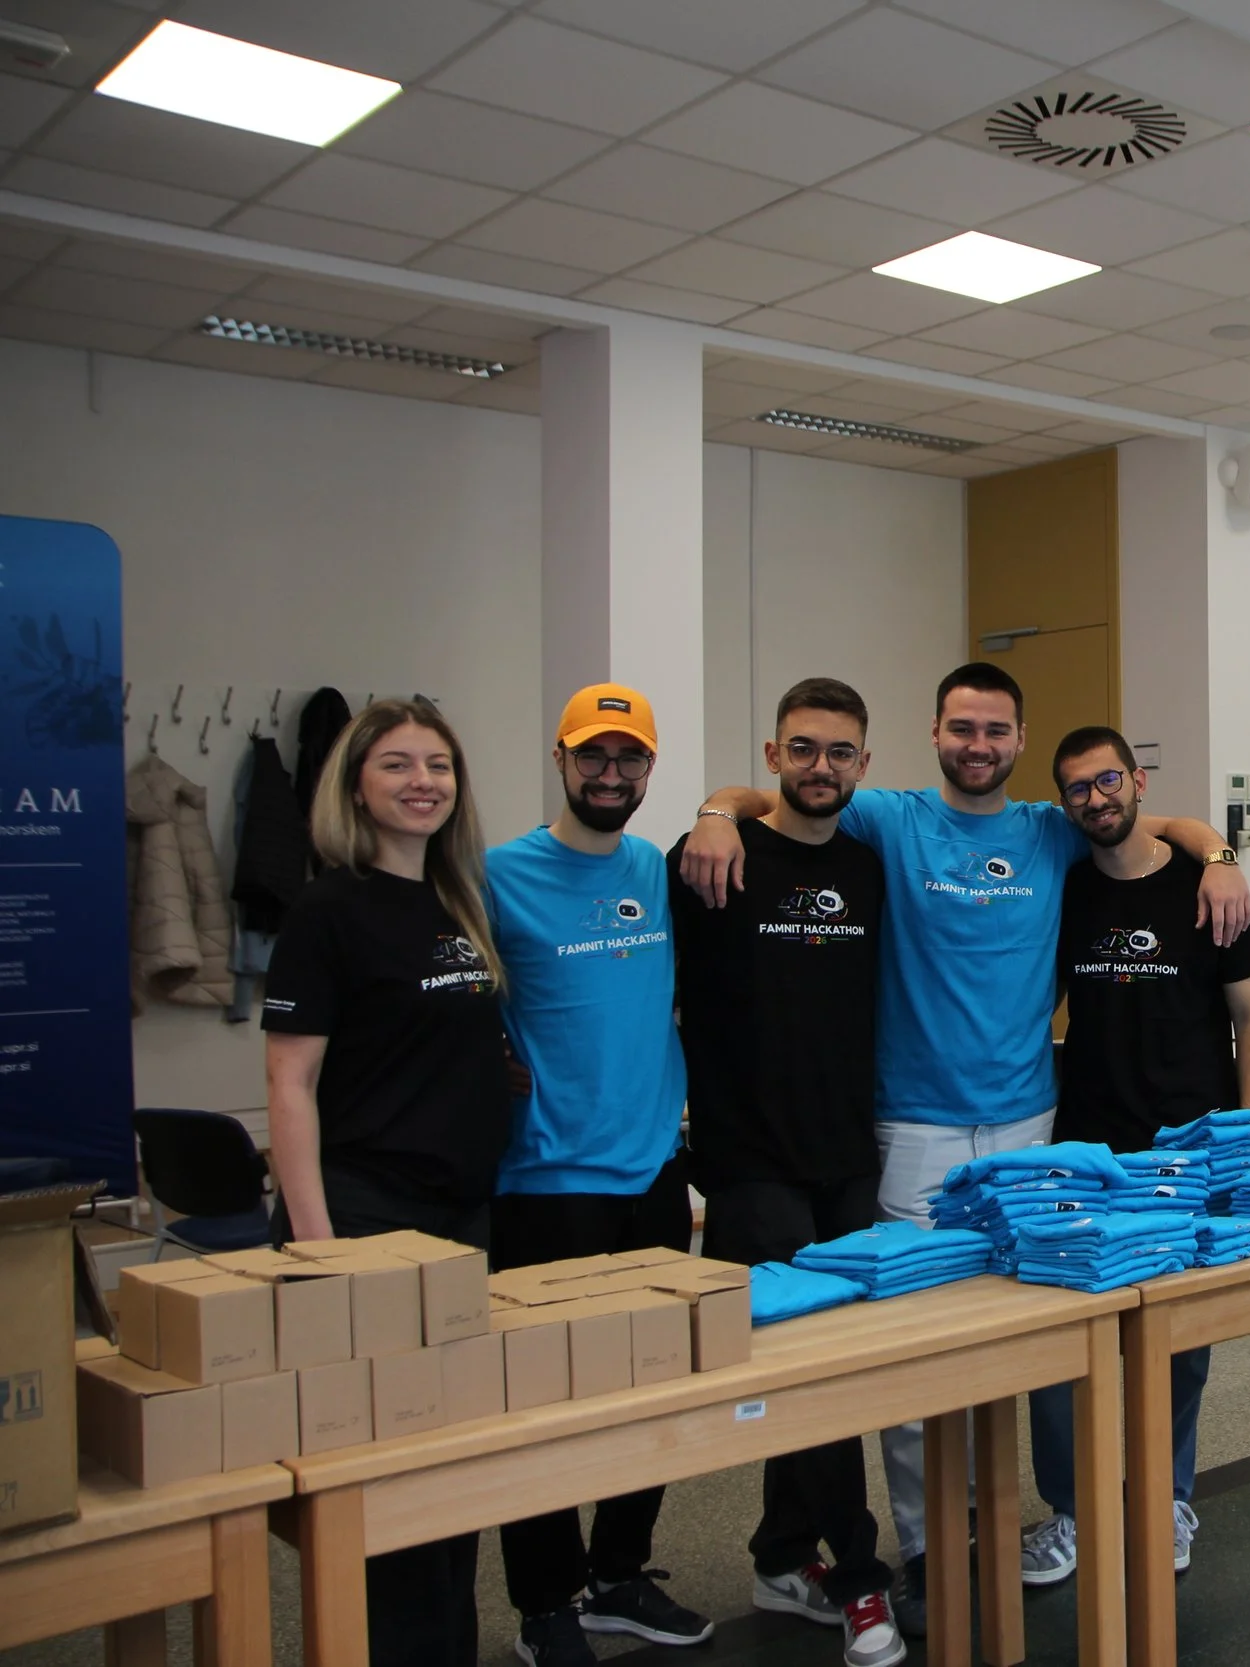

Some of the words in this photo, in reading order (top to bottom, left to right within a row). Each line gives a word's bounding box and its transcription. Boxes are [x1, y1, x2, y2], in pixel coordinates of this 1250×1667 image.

[0, 788, 83, 813] AM
[925, 881, 967, 895] FAMNIT
[969, 886, 1033, 896] HACKATHON
[759, 923, 802, 934] FAMNIT
[803, 924, 865, 936] HACKATHON
[557, 940, 605, 957] FAMNIT
[607, 931, 668, 949] HACKATHON
[804, 936, 828, 945] 2026
[1075, 963, 1111, 973] FAMNIT
[1113, 963, 1179, 976] HACKATHON
[421, 973, 461, 990] FAMNIT
[463, 971, 490, 981] HACKA
